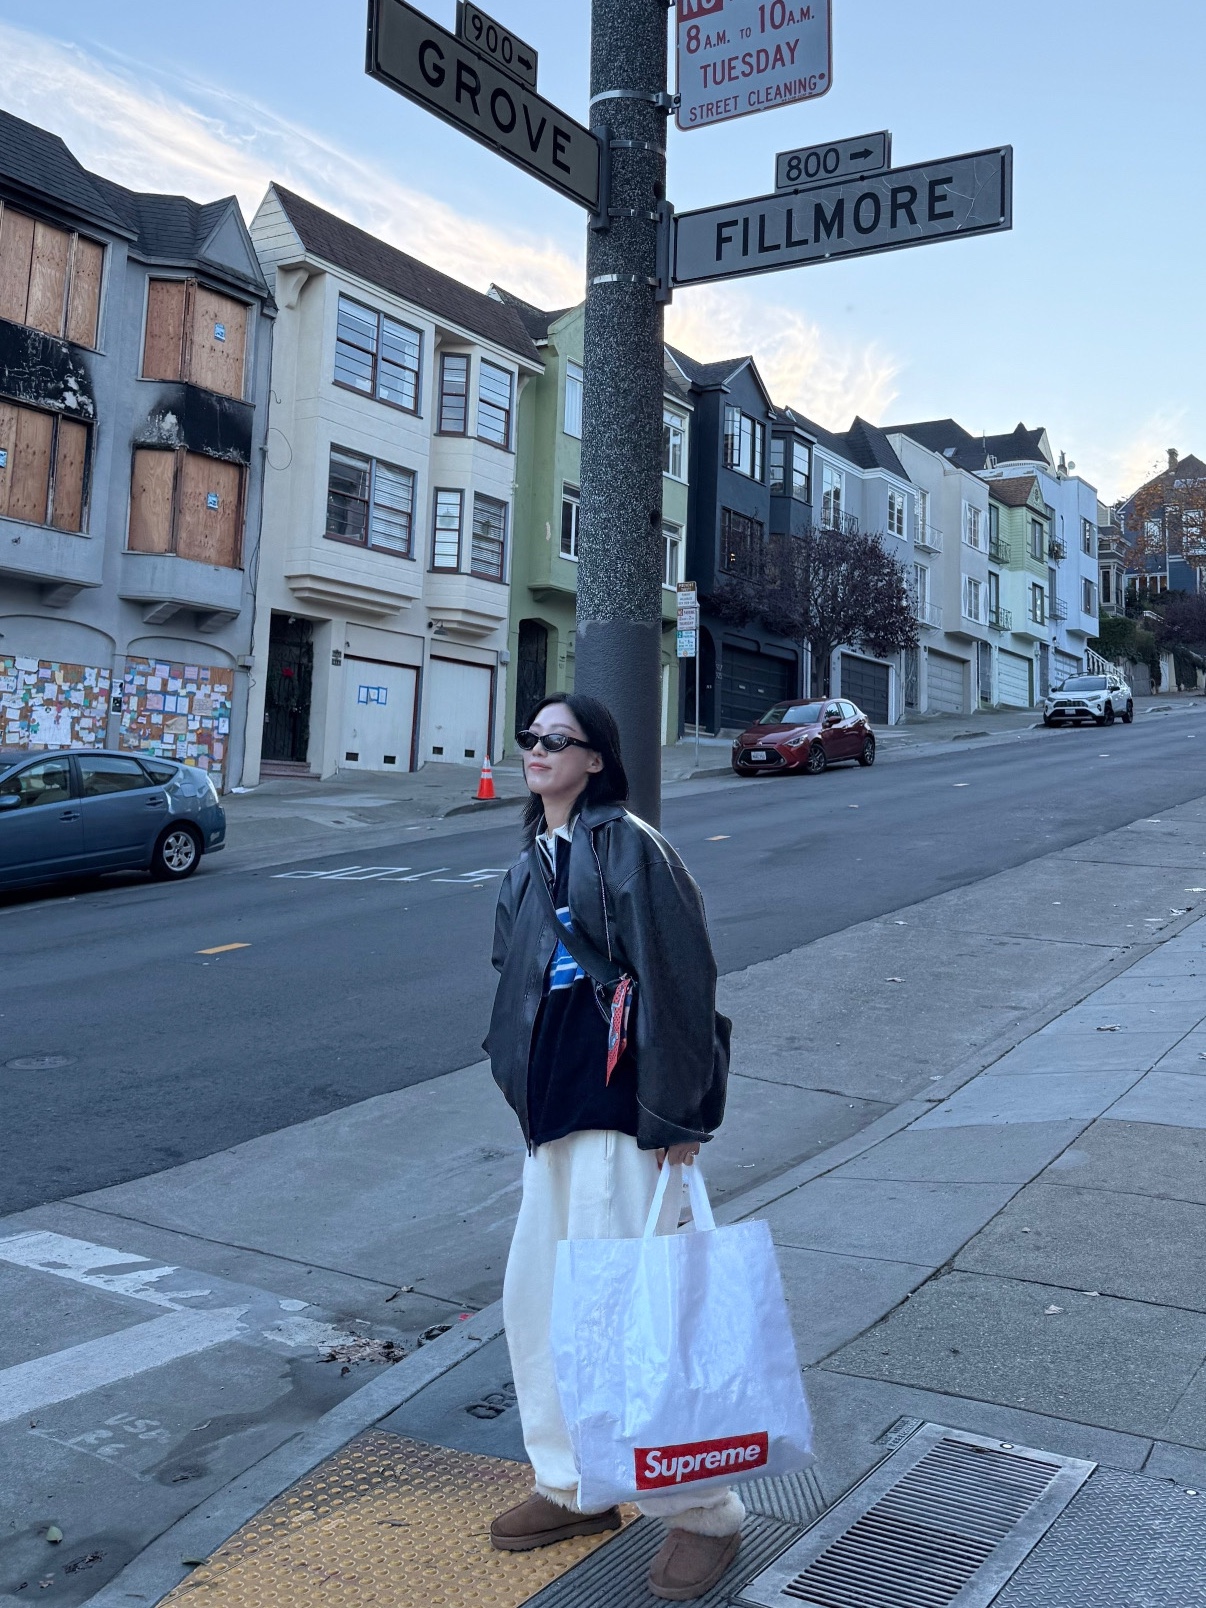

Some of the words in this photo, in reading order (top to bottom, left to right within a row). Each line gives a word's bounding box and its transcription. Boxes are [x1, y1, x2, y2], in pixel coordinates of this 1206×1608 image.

[471, 14, 513, 64] 900
[740, 27, 752, 40] TO
[700, 39, 800, 89] TUESDAY
[418, 39, 571, 175] GROVE
[689, 95, 740, 122] STREET
[748, 75, 817, 107] CLEANING
[785, 147, 840, 182] 800
[715, 176, 954, 262] FILLMORE
[270, 865, 509, 883] STOP
[644, 1444, 761, 1482] Supreme
